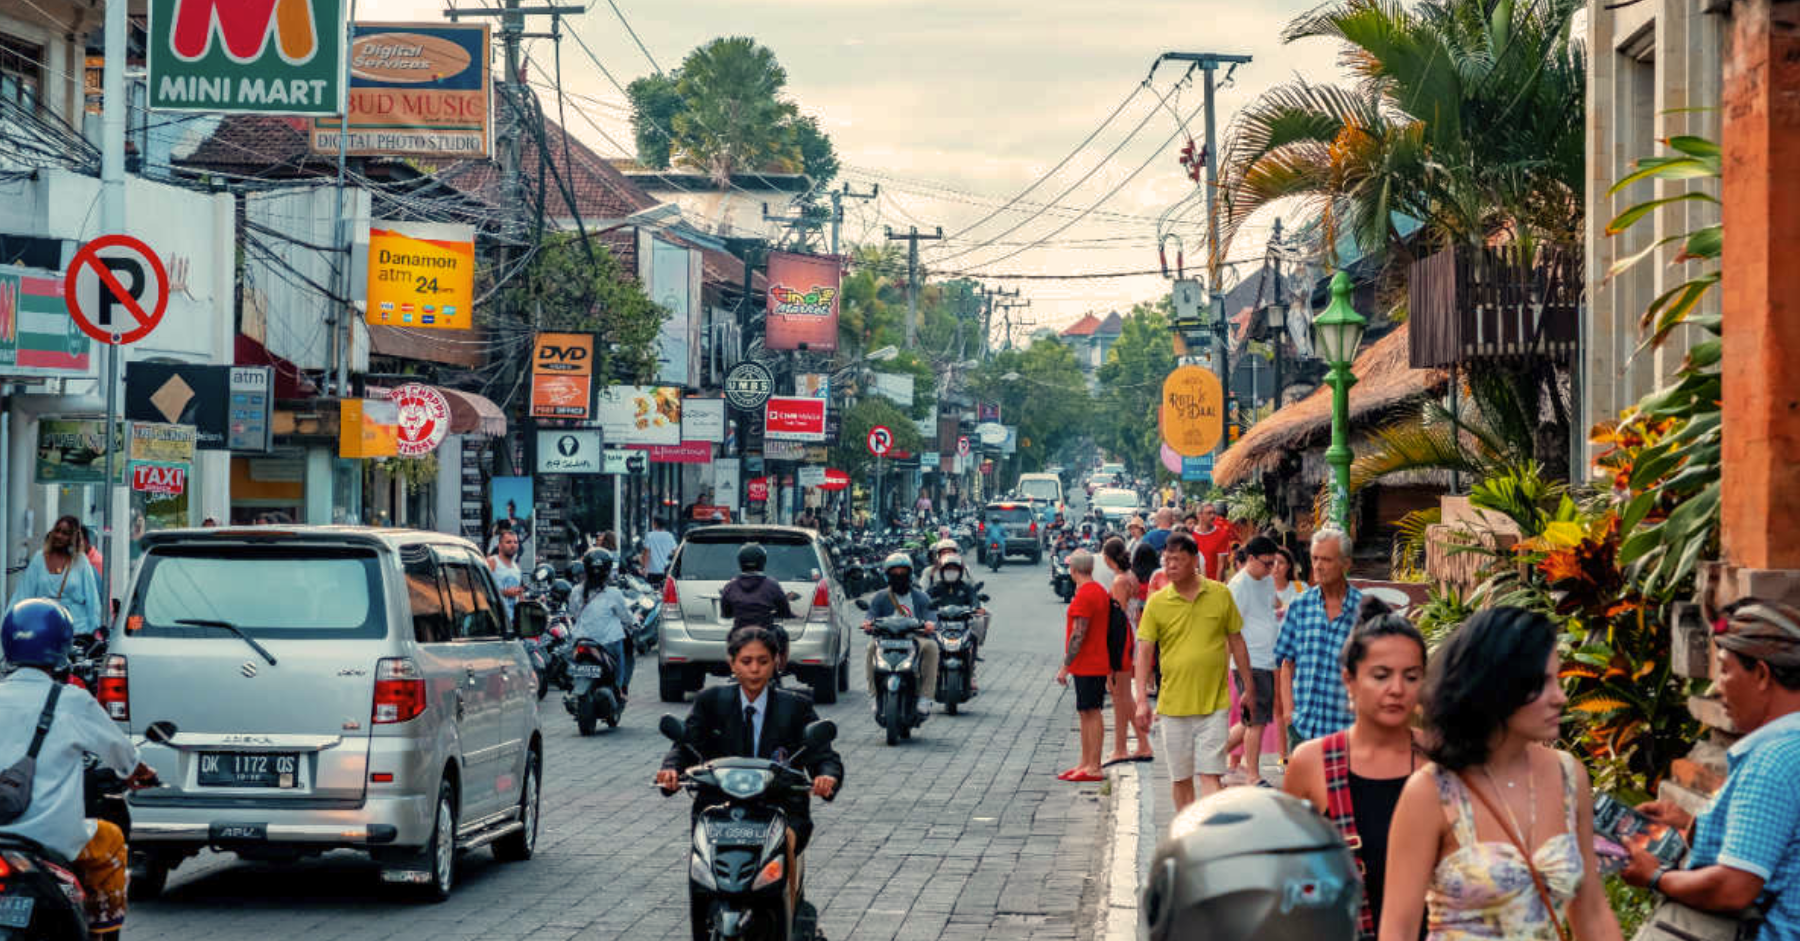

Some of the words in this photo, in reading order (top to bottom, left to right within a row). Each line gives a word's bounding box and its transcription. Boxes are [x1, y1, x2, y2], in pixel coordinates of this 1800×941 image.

[363, 43, 424, 59] Digital
[352, 55, 431, 70] Services
[158, 75, 231, 103] MINI
[237, 77, 328, 106] MART
[401, 93, 483, 117] MUSIC
[317, 133, 371, 150] DIGTAL
[377, 134, 425, 150] PHOTO
[426, 135, 480, 151] STUDIO
[379, 249, 457, 270] Danamon
[377, 267, 412, 283] atm
[415, 275, 439, 294] 24
[775, 303, 830, 317] Market
[539, 345, 587, 362] DVD
[233, 371, 264, 385] atm
[136, 468, 182, 487] TAXI
[202, 755, 220, 773] DK
[235, 756, 268, 773] 1172
[277, 756, 295, 773] QS
